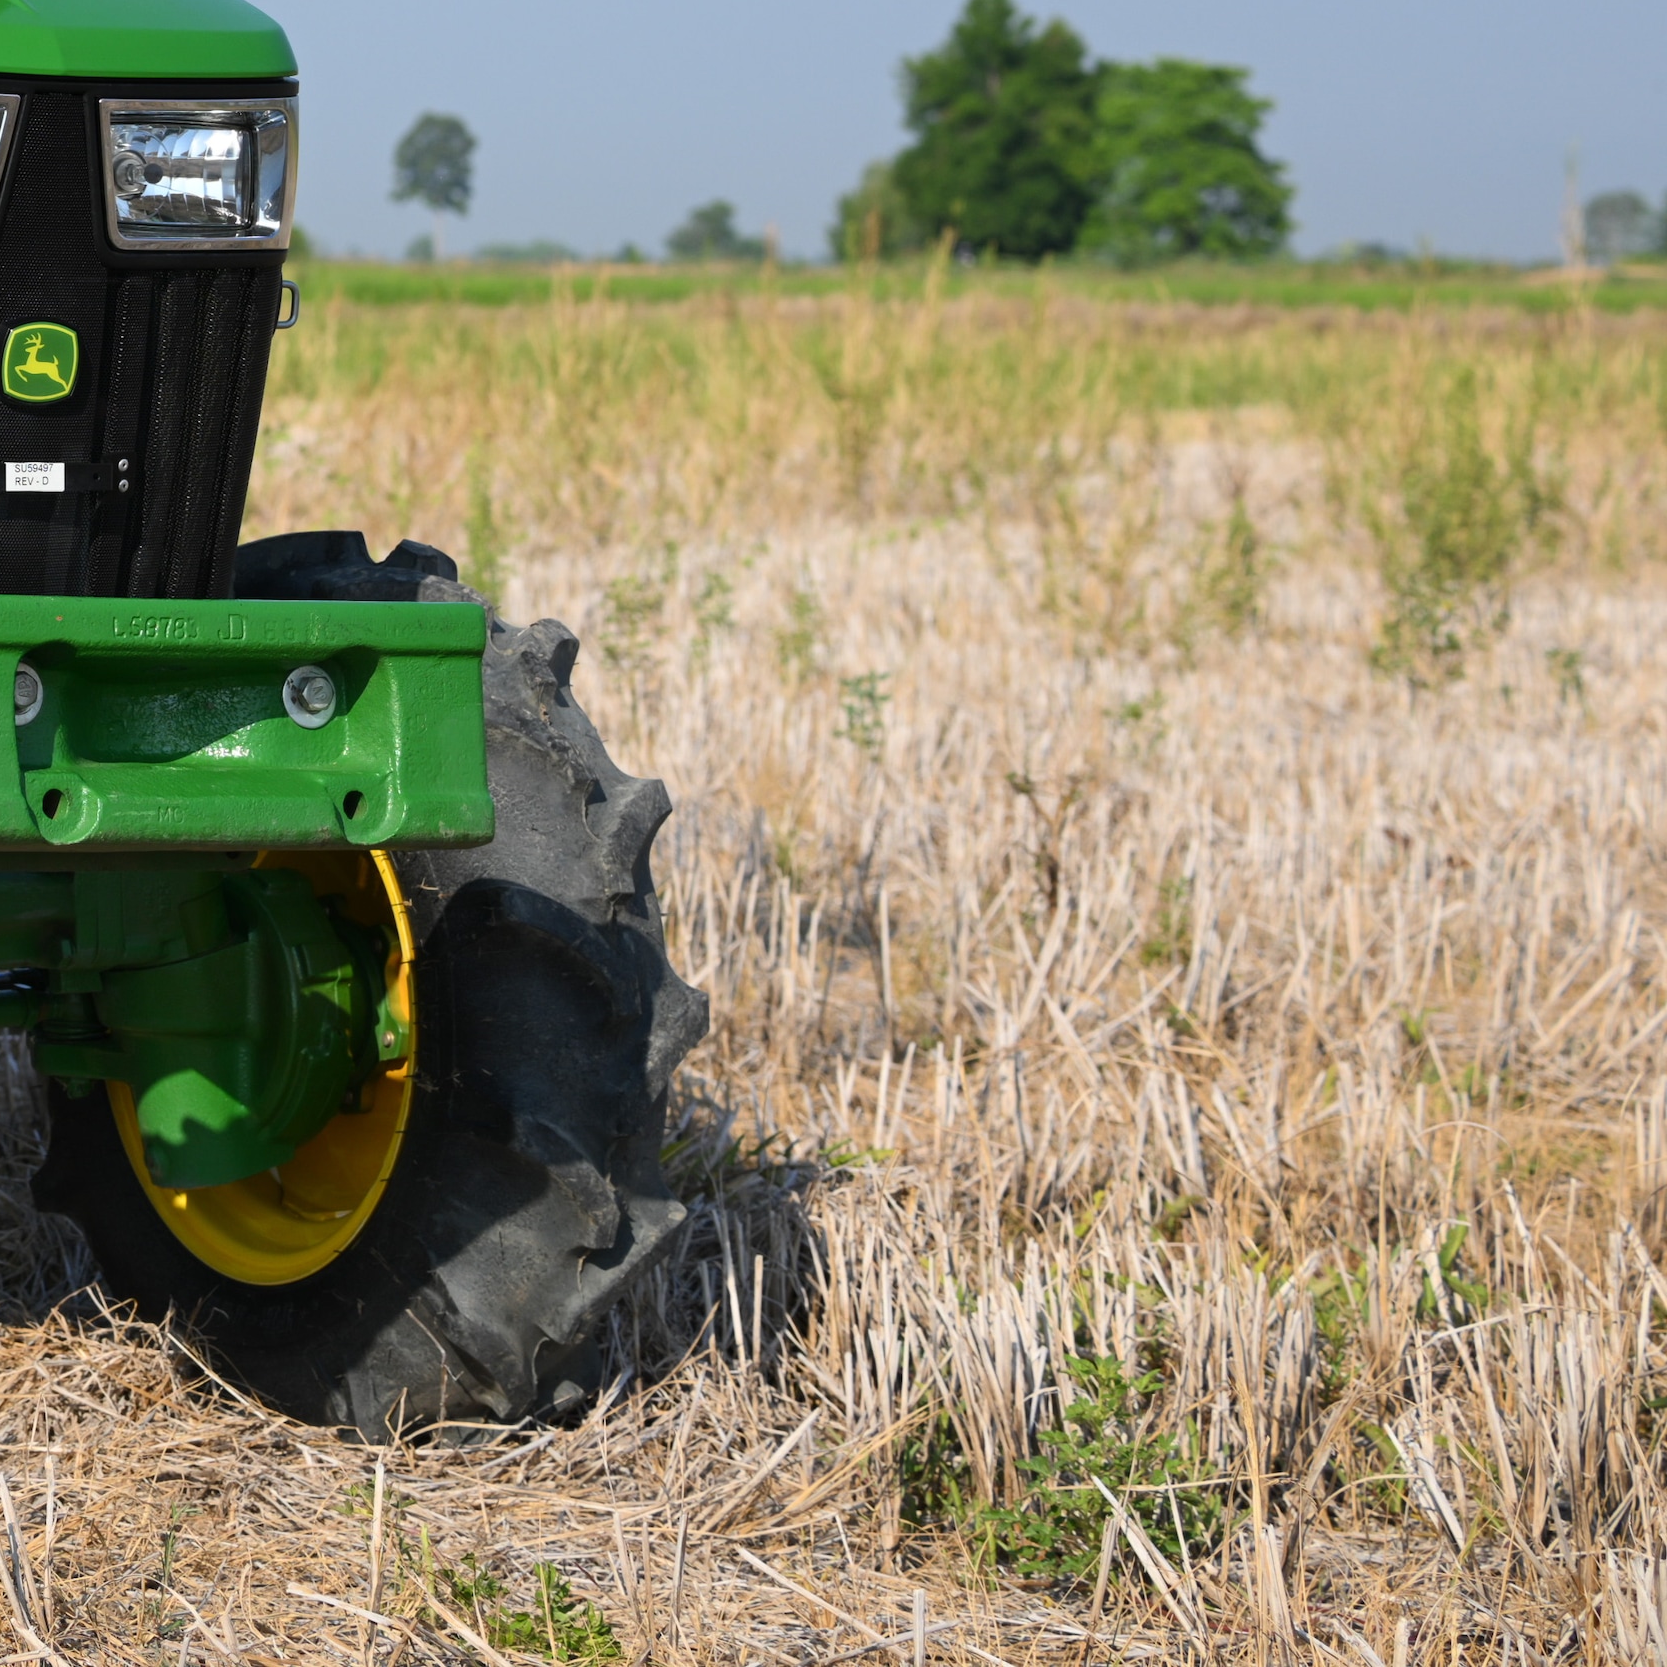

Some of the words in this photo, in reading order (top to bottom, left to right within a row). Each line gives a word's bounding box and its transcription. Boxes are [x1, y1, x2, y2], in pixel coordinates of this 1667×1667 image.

[14, 463, 54, 473] SU59497
[15, 476, 34, 486] REV
[42, 476, 49, 485] D
